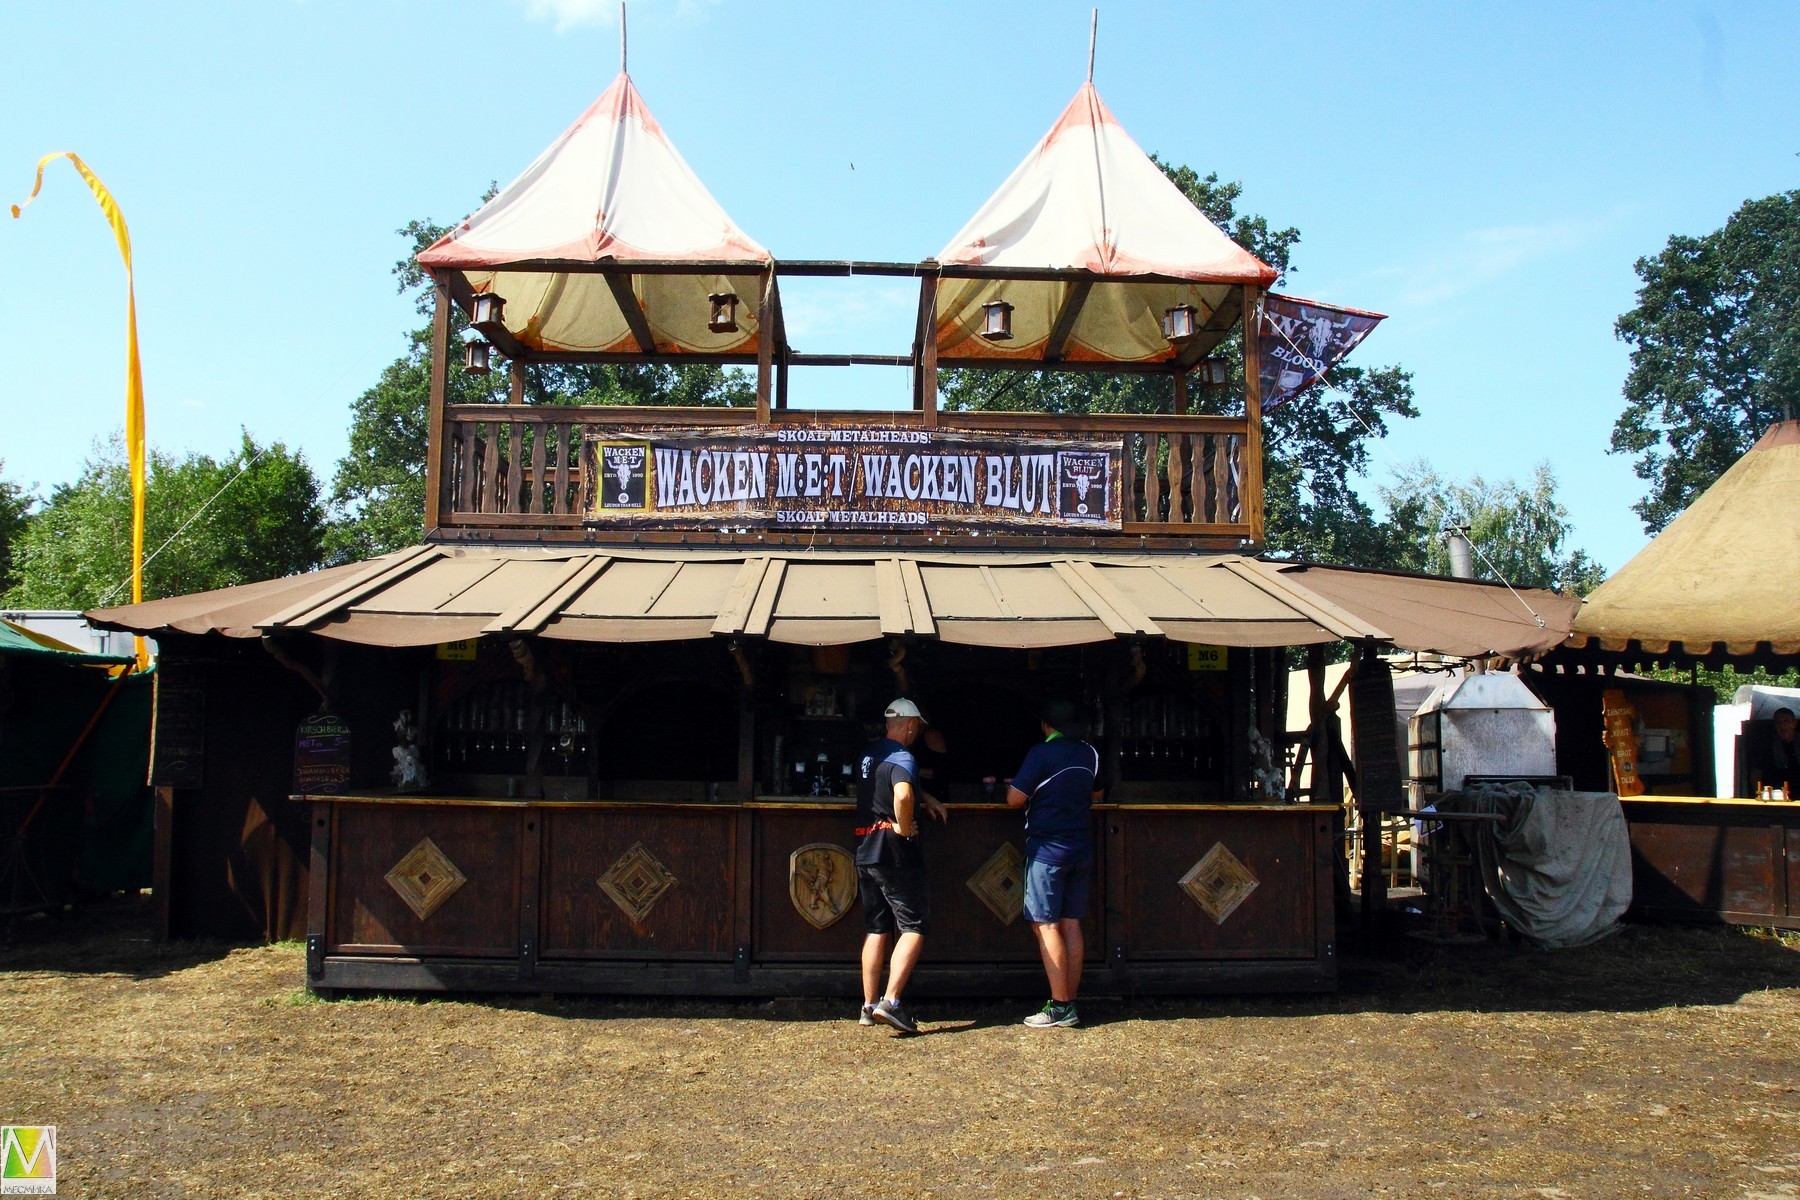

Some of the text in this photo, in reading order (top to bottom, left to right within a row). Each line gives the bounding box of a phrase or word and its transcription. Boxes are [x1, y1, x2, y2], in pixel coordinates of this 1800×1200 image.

[1270, 345, 1326, 371] BLOOD
[777, 430, 931, 443] SKOAL METALHEADS!
[603, 447, 645, 457] WACKEN
[1063, 457, 1104, 467] WACKEN
[655, 448, 769, 507] WACKEN
[775, 453, 845, 498] M:E:T
[862, 452, 977, 504] WACKEN
[984, 454, 1054, 513] BLUT
[776, 511, 929, 524] SKOAL METALHEADS!
[1199, 650, 1218, 661] M6
